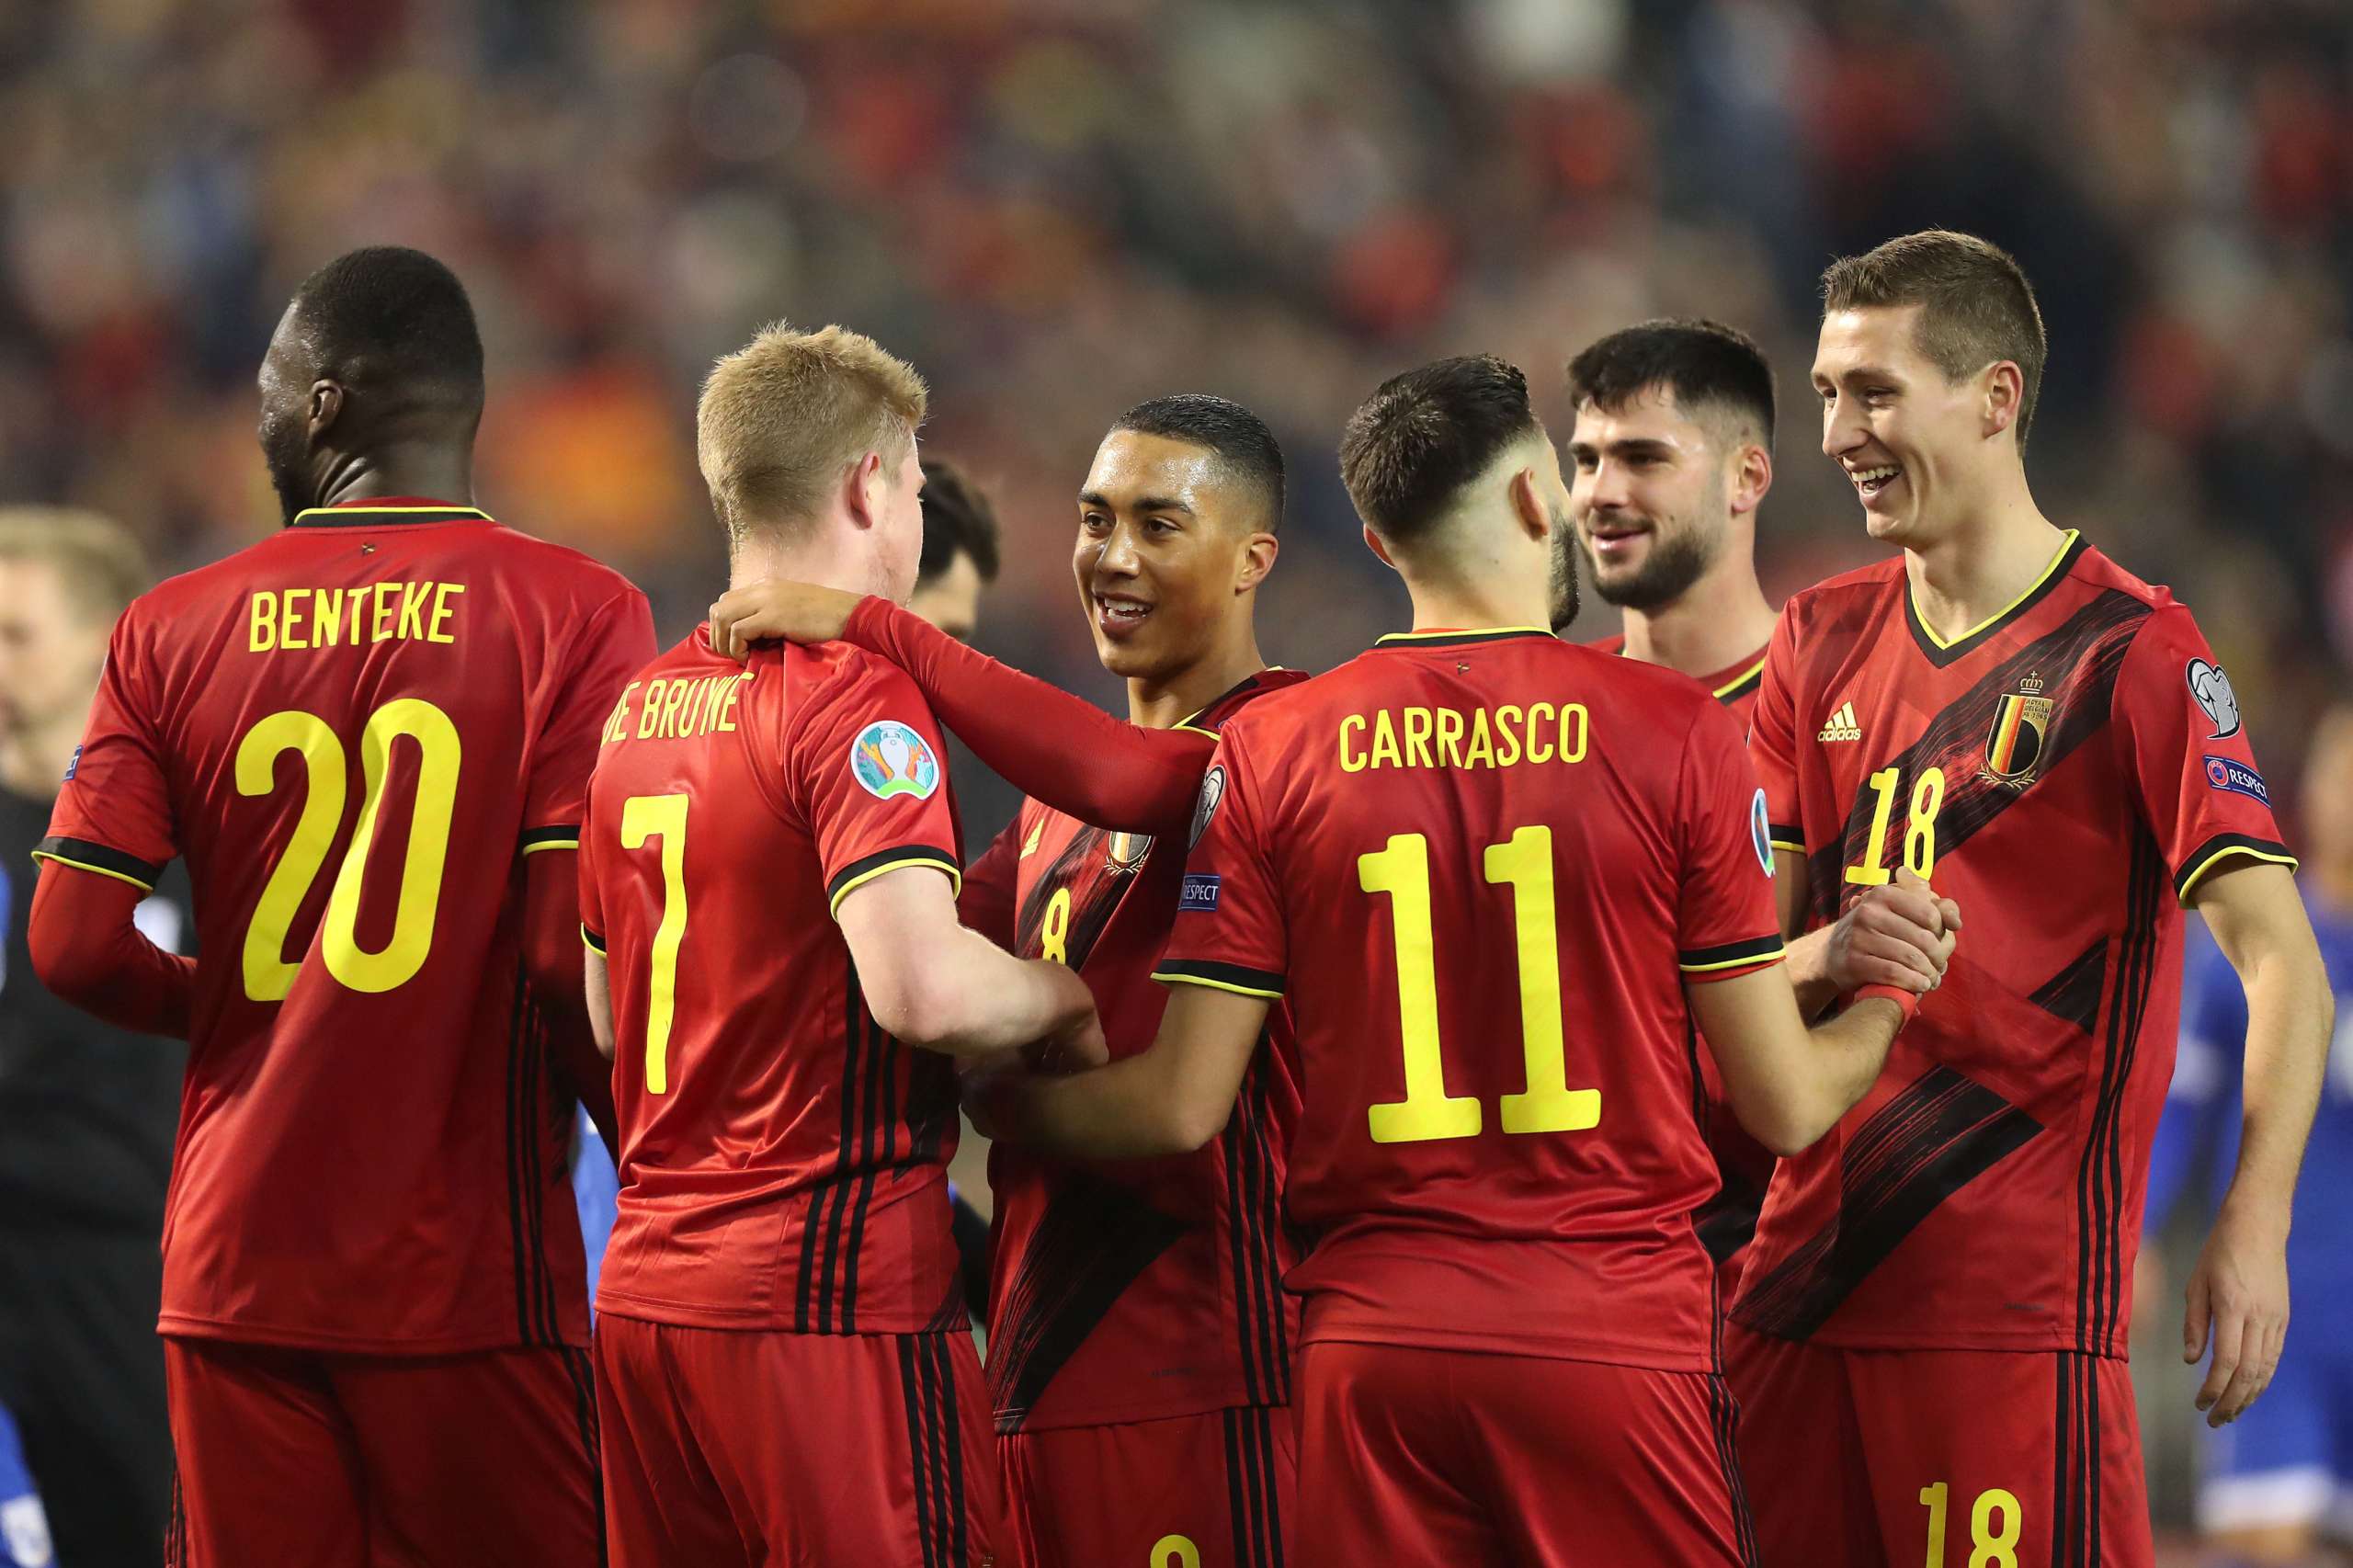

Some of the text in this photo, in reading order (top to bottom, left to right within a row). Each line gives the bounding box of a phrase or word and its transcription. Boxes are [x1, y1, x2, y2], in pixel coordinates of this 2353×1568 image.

[250, 582, 465, 652] BENTEKE
[1339, 702, 1588, 772] CARRASCO
[1817, 727, 1861, 742] adidas
[2229, 768, 2268, 800] RESPECT
[235, 699, 461, 1001] 20
[1845, 767, 1945, 885] 18
[620, 793, 689, 1094] 7
[1041, 888, 1070, 965] 8
[1357, 825, 1602, 1142] 11
[1919, 1482, 2022, 1568] 18
